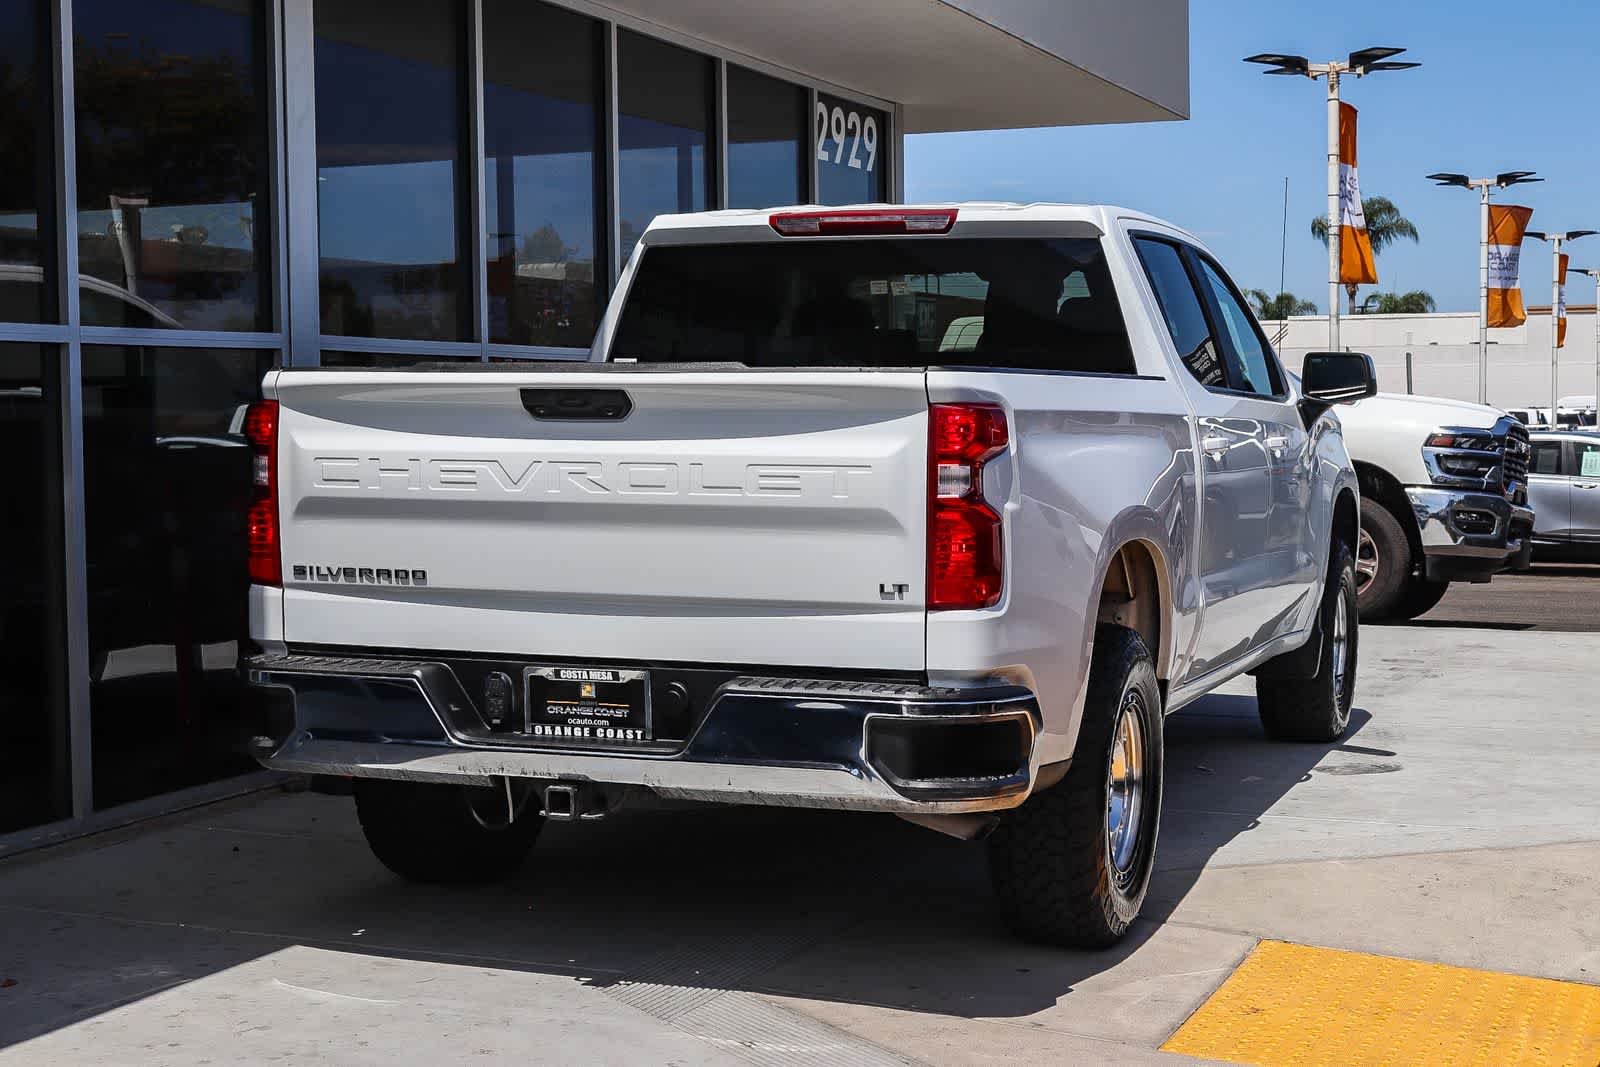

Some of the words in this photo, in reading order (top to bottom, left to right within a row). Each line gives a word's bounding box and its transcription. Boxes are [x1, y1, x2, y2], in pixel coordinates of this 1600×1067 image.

[817, 101, 877, 172] 2929
[312, 456, 873, 499] CHEVROLET
[293, 565, 427, 585] SILVERADO
[879, 583, 909, 601] LT
[560, 670, 588, 679] COSTA
[589, 671, 613, 680] MESA
[547, 705, 593, 715] ORANGE
[594, 708, 629, 717] COAST
[567, 718, 609, 726] ocauto.com
[534, 725, 590, 737] ORANGE
[596, 728, 644, 740] COAST
